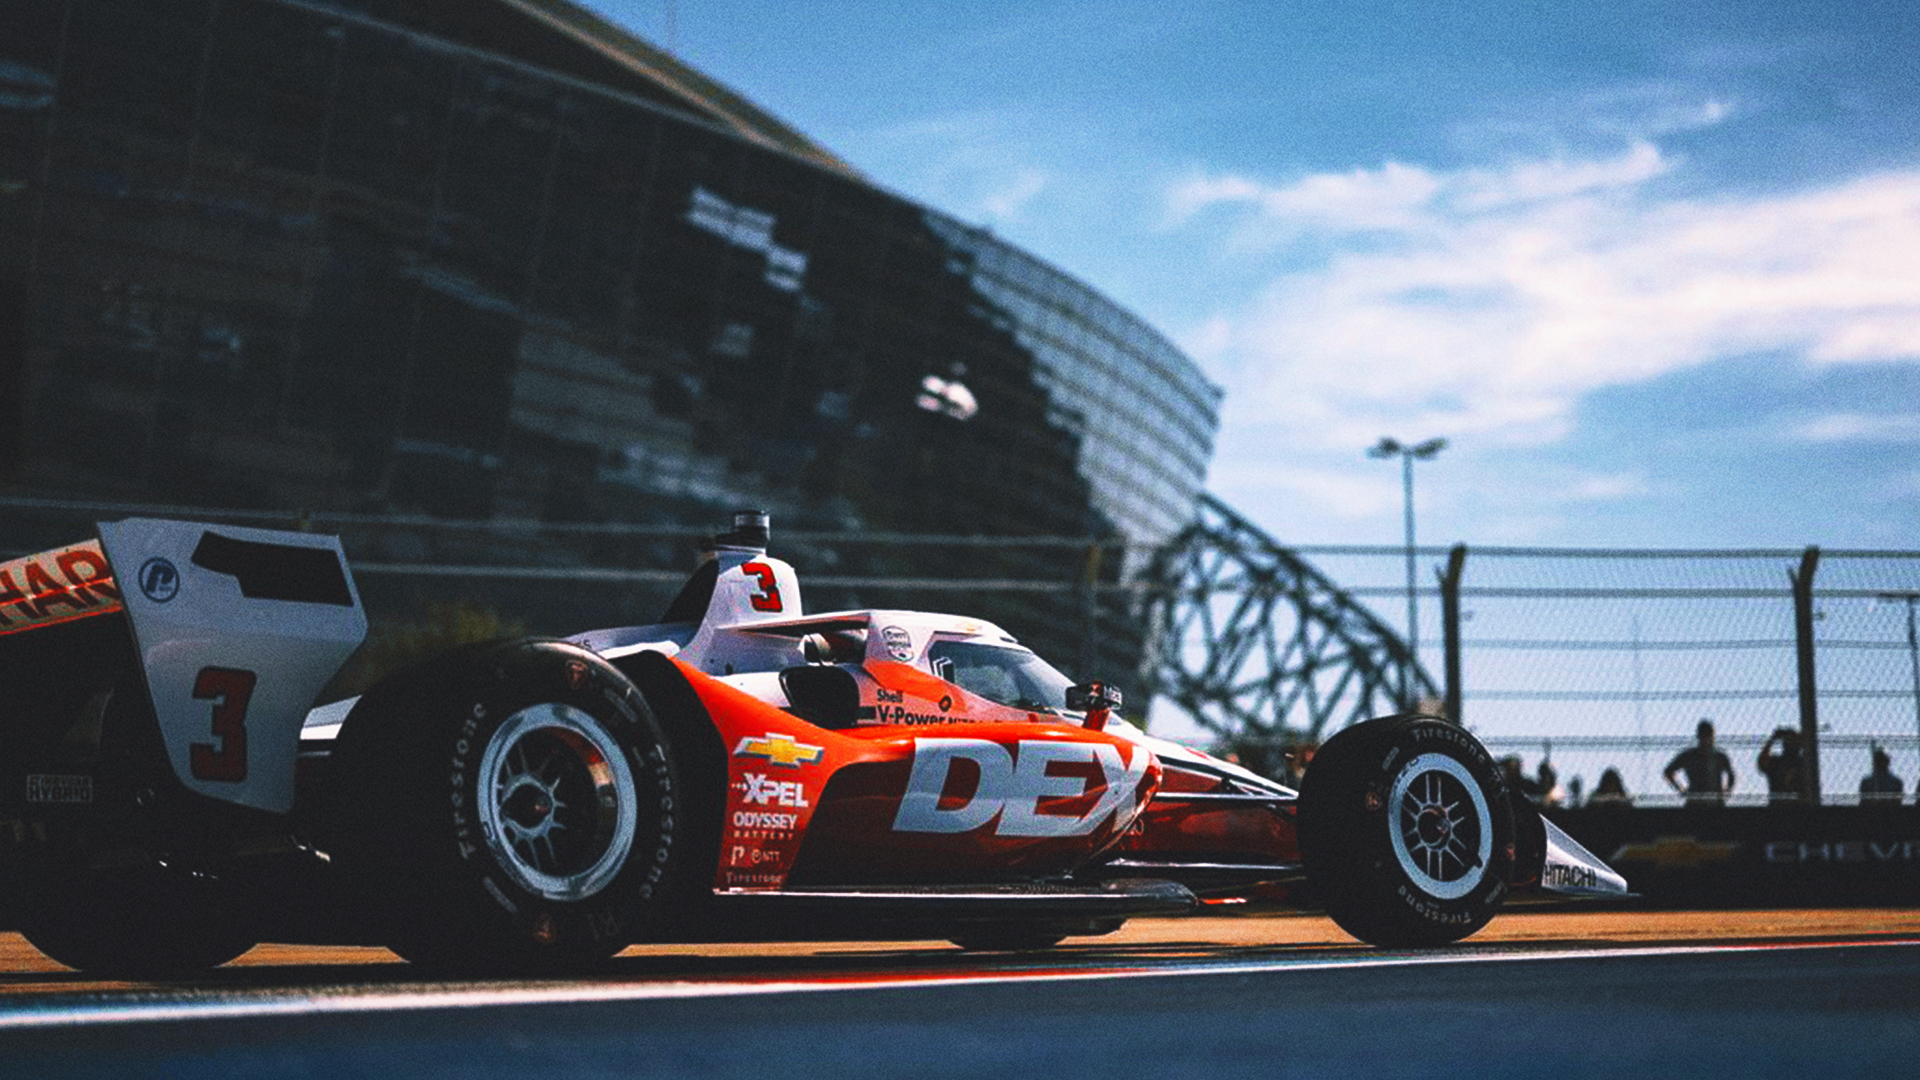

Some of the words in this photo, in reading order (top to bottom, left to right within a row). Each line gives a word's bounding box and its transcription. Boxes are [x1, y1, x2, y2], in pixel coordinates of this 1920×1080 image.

[741, 562, 783, 613] 3
[190, 666, 257, 783] 3
[878, 705, 946, 725] V-Power
[1410, 726, 1487, 764] Firestone
[452, 702, 488, 861] Firestone
[742, 772, 809, 808] XPEL
[892, 738, 1151, 837] DEX
[733, 811, 798, 831] ODYSSEY
[1545, 864, 1597, 887] HITACHI
[1397, 884, 1472, 926] Firestone
